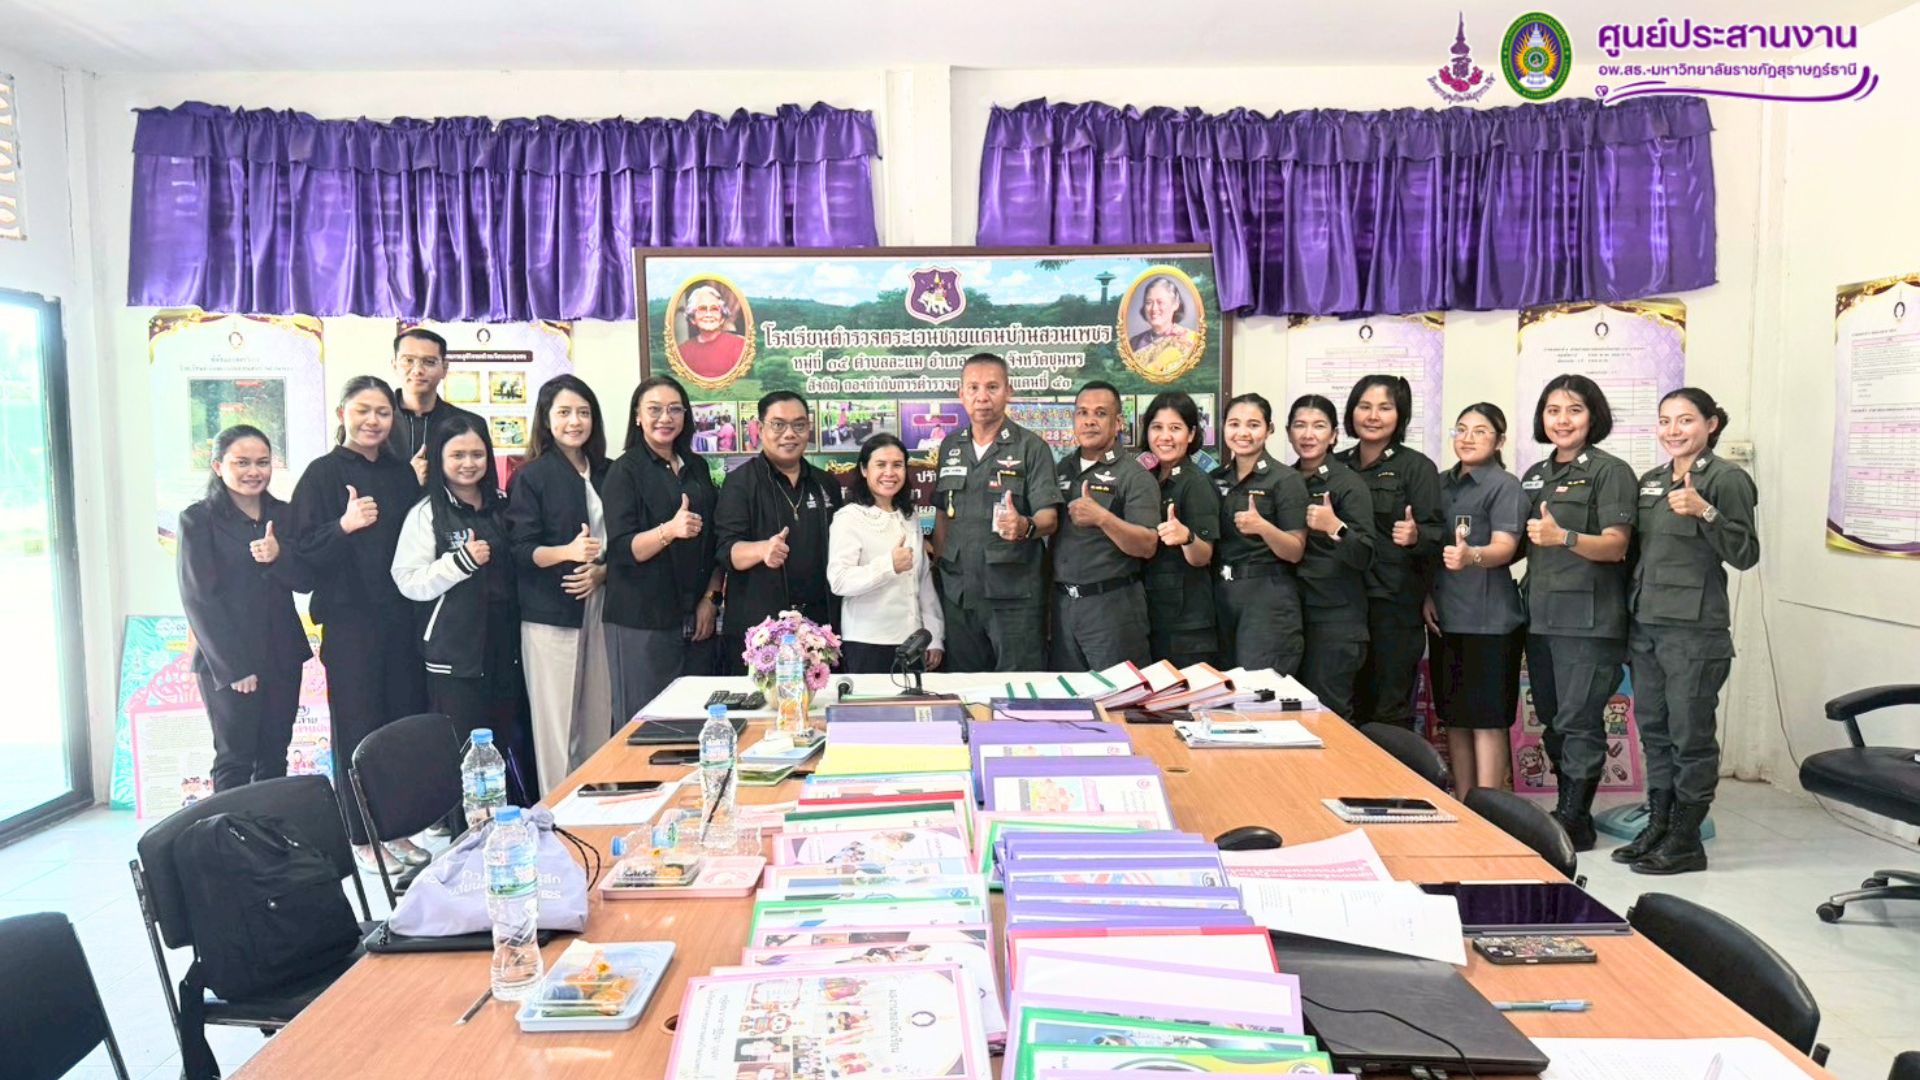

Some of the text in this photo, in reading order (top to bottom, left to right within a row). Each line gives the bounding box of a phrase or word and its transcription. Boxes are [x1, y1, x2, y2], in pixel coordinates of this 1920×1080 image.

[762, 321, 1111, 347] โรงเรียนตำรวจตระเวนชายแดนบ้านสวนเพชร
[793, 350, 823, 374] หมู่ที่
[853, 352, 925, 370] ตำบลละแม
[1006, 350, 1086, 371] จังหวัดชุมพร
[807, 376, 840, 394] สังกัด
